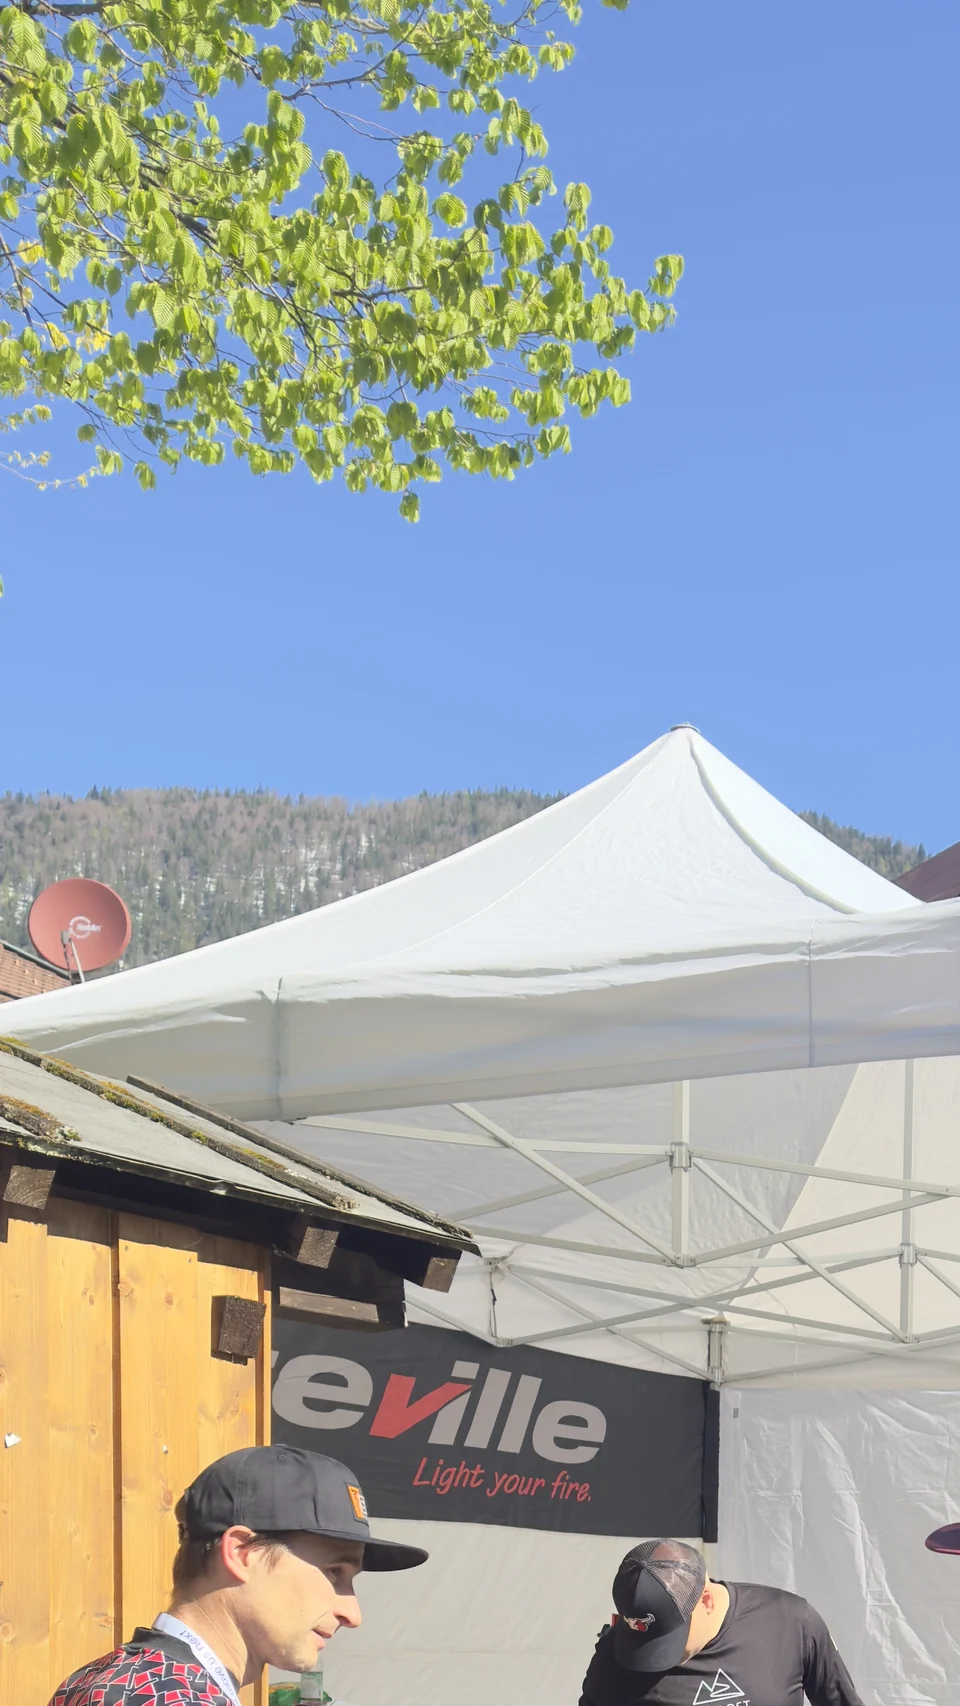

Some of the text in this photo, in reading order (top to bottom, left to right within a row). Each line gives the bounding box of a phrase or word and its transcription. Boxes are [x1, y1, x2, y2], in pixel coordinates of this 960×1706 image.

[271, 1351, 607, 1464] eville
[413, 1457, 592, 1502] Light your fire.
[179, 1630, 204, 1651] next
